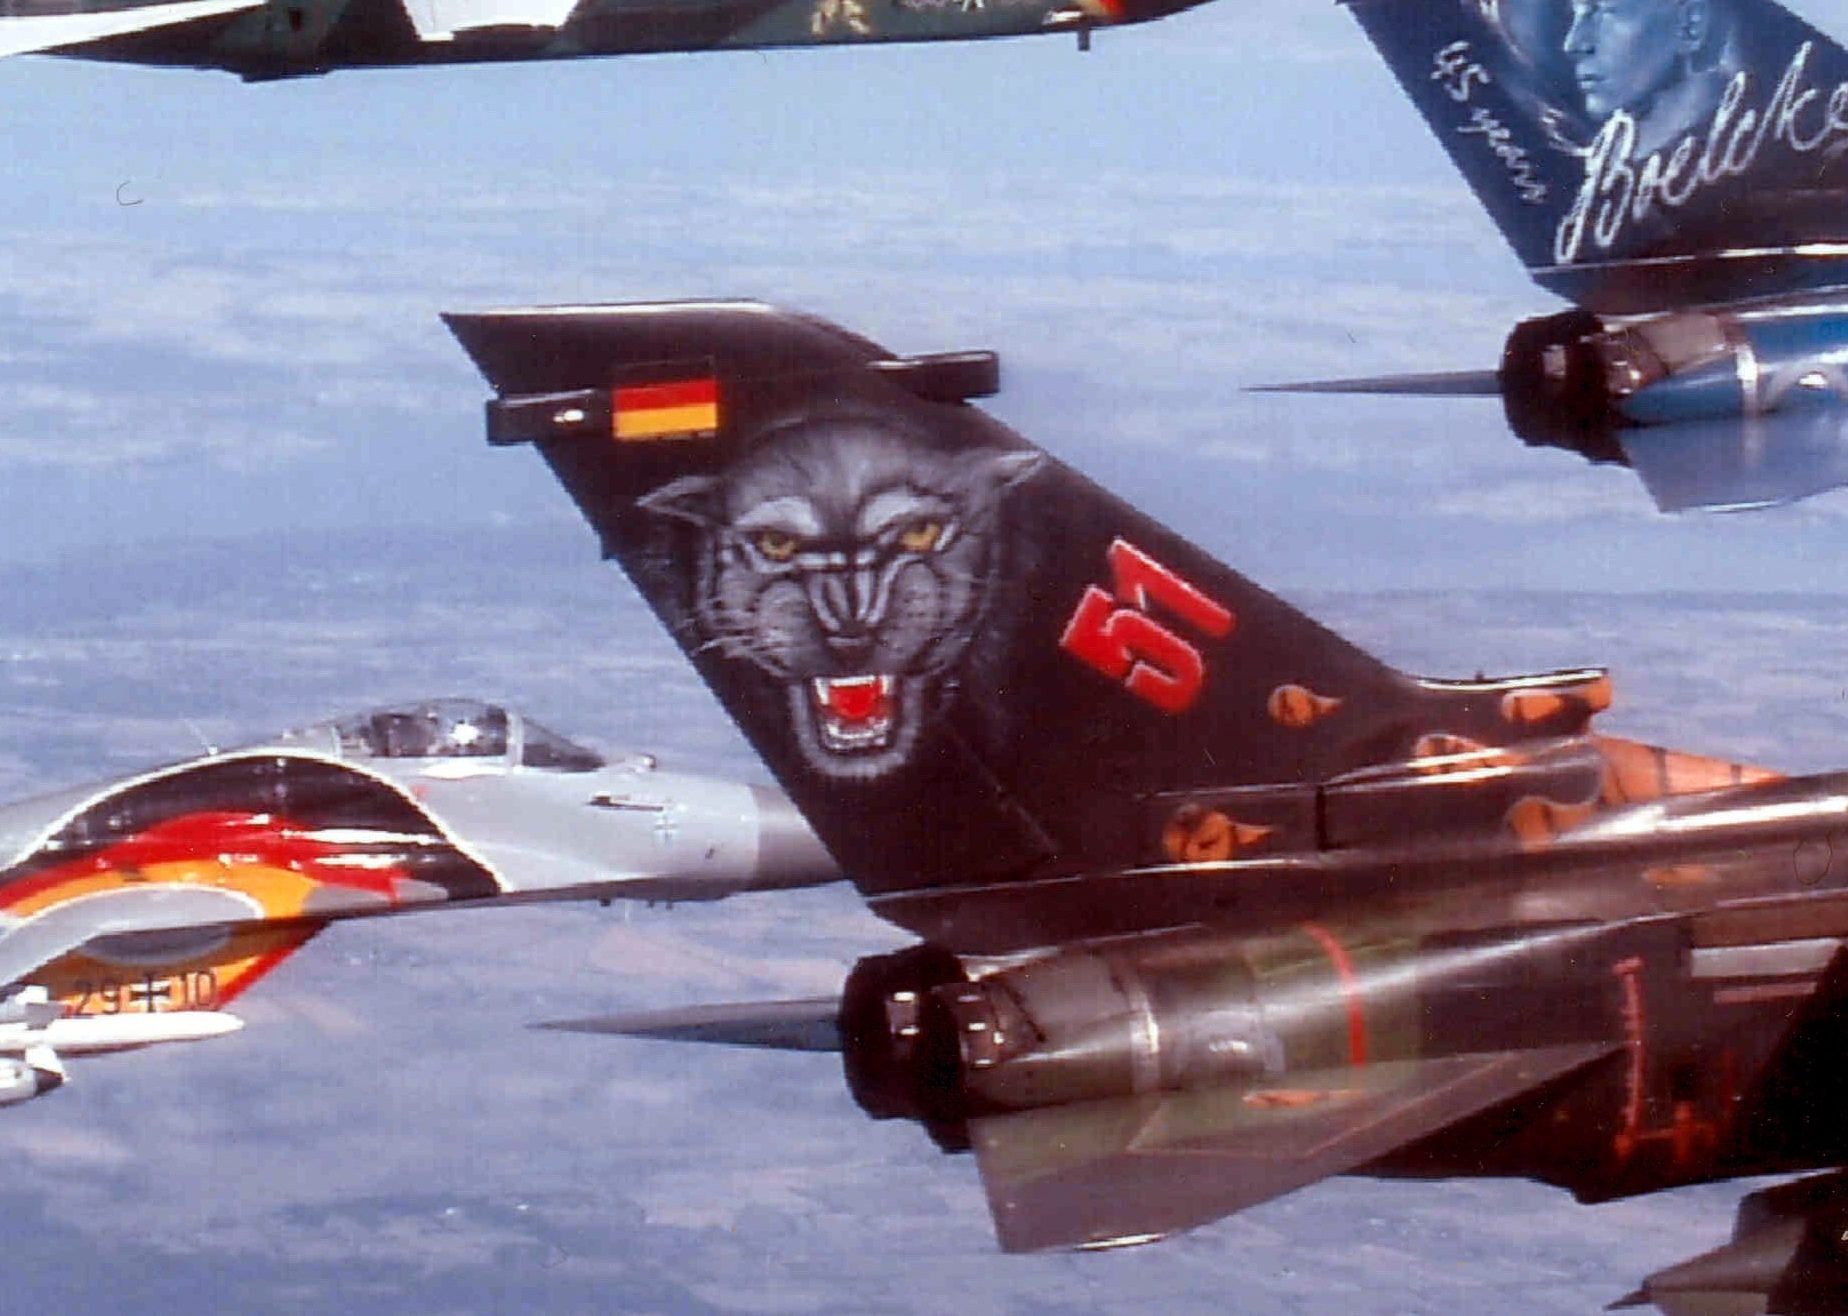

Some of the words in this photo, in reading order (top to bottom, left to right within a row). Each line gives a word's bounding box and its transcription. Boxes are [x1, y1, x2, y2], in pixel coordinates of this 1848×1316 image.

[1058, 536, 1235, 712] 51
[74, 978, 120, 1017] 29
[179, 970, 216, 1008] 10
